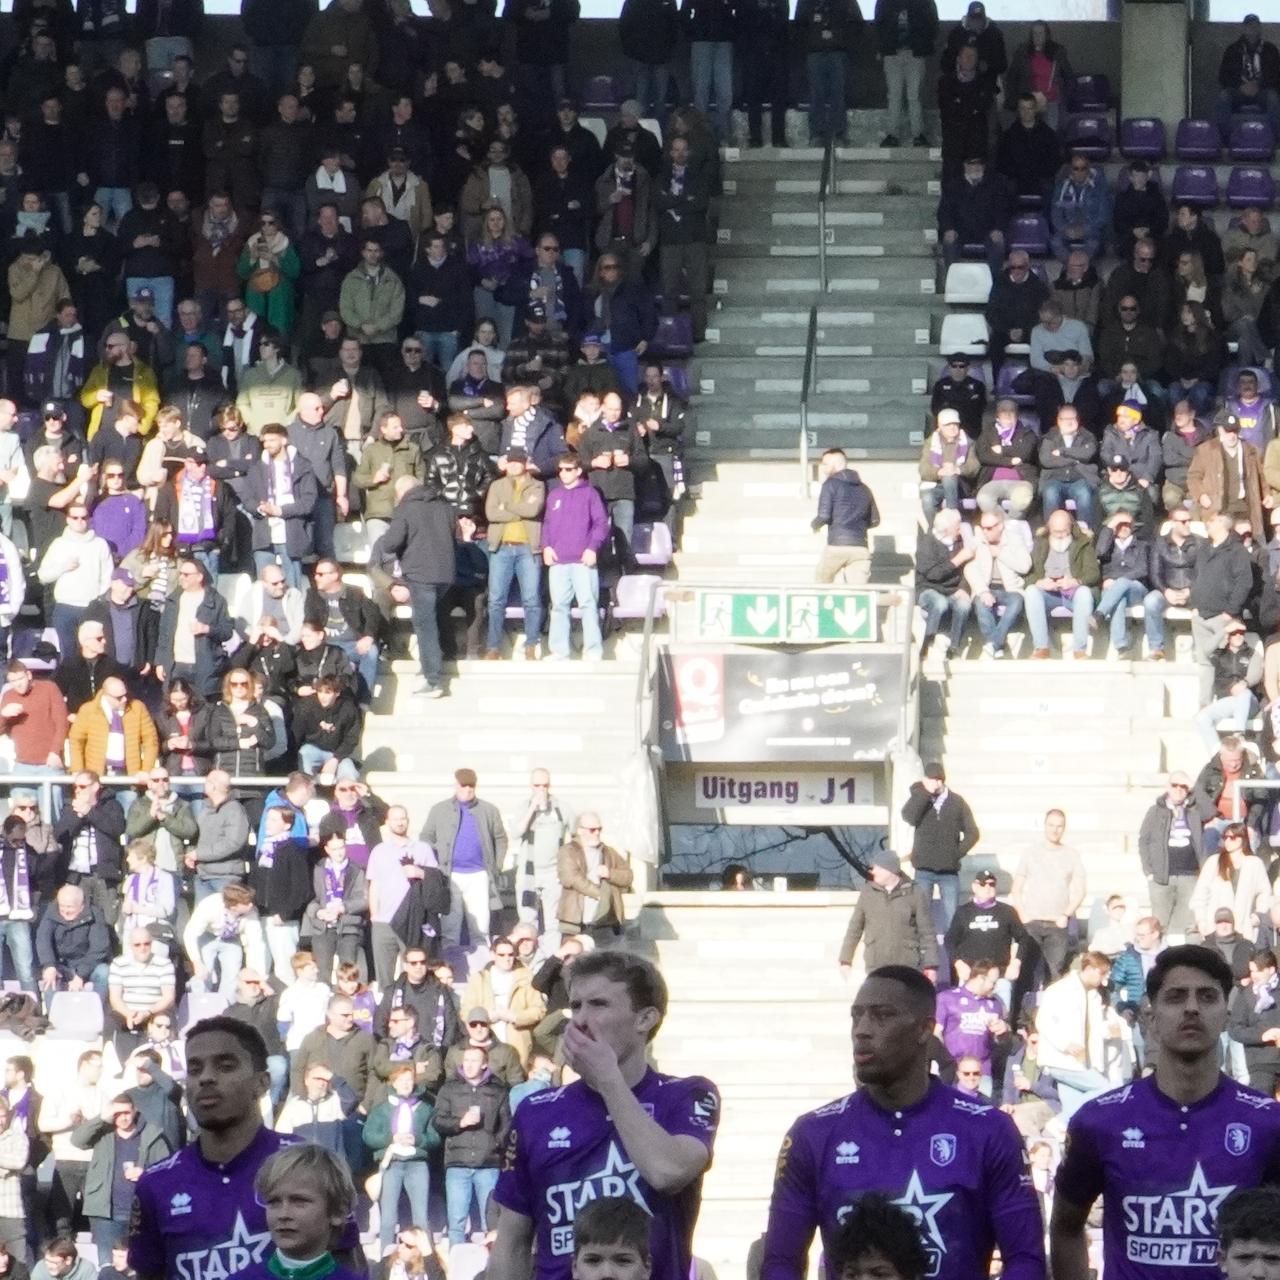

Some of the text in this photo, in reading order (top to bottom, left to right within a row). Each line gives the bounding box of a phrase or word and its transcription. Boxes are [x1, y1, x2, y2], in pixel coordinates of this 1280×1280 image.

[702, 776, 856, 804] Uitgang J1
[1122, 1195, 1211, 1235] STAR
[1130, 1240, 1217, 1260] SPORT TV
